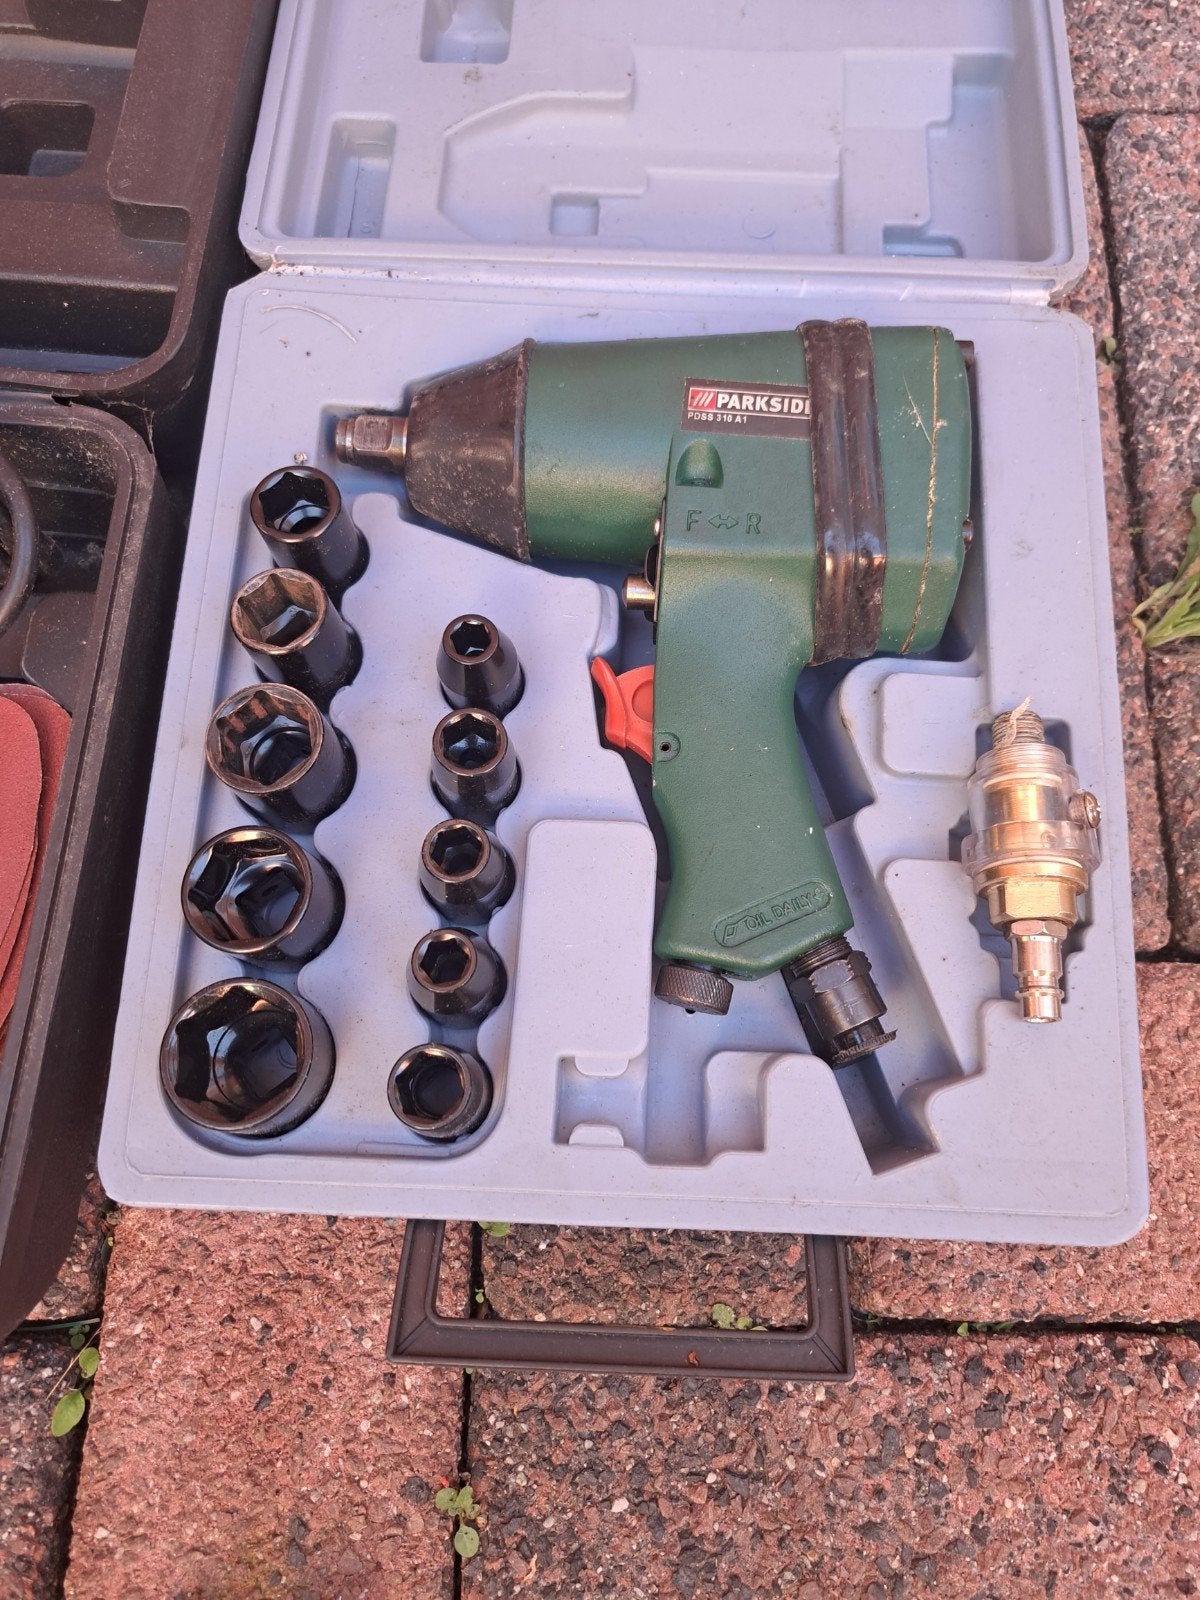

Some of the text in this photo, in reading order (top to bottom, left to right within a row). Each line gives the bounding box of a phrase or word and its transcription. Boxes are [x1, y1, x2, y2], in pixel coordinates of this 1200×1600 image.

[687, 411, 748, 424] PDSS 310 A1
[686, 509, 762, 535] F R
[745, 892, 812, 931] OIL DAILY
